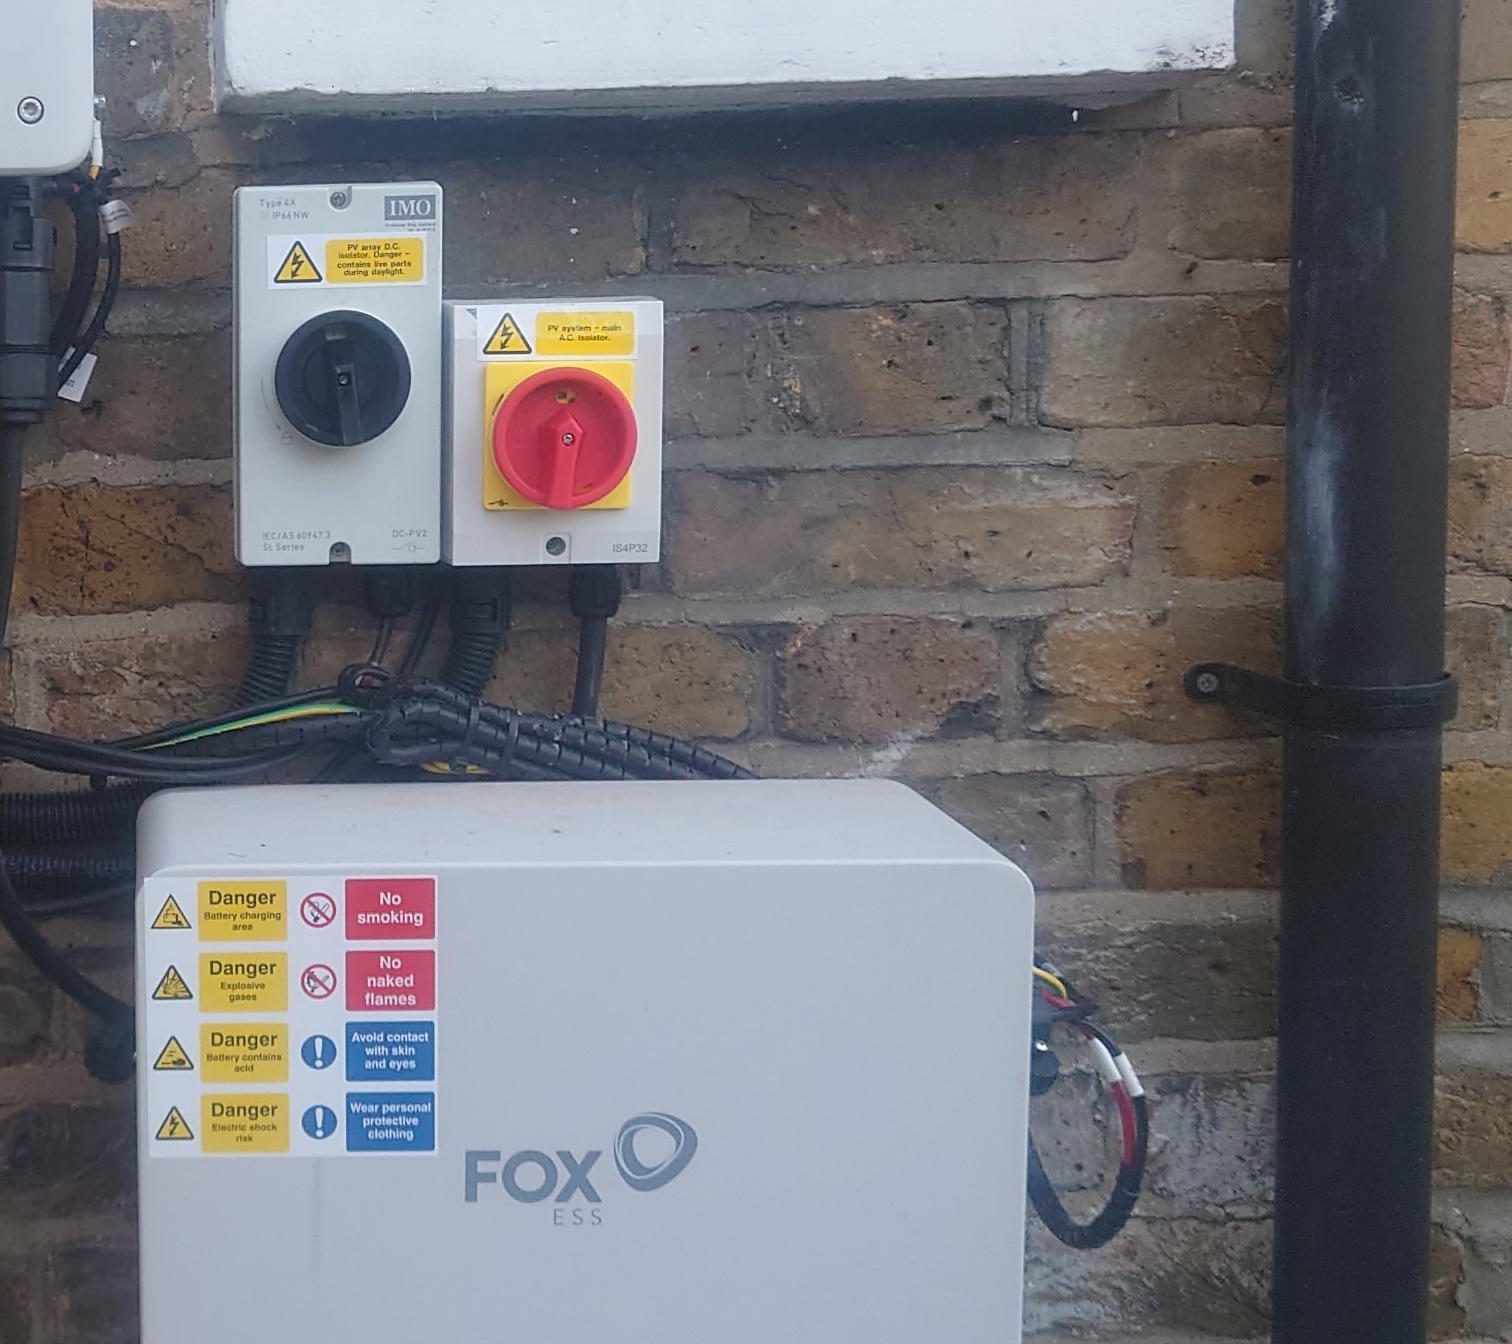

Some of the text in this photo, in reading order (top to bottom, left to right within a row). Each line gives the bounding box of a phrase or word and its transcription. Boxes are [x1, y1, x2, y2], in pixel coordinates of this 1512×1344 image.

[389, 198, 431, 216] IMO
[361, 244, 382, 252] array
[373, 250, 402, 259] Danger
[337, 260, 412, 269] contains live parts
[343, 269, 368, 277] during
[547, 324, 559, 332] PV
[562, 325, 591, 333] system
[612, 543, 649, 553] IS4P32
[208, 890, 277, 909] Danger
[379, 891, 402, 906] No
[203, 911, 282, 921] Battery charging
[357, 910, 424, 927] smoking
[379, 955, 402, 969] No
[209, 960, 277, 979] Danger
[220, 981, 265, 991] Explosive
[367, 973, 414, 988] naked
[228, 994, 257, 1003] gases
[364, 992, 417, 1006] flames
[210, 1032, 278, 1051] Danger
[351, 1031, 429, 1043] Avoid contact
[364, 1045, 416, 1056] with skin
[206, 1052, 282, 1063] Battery contains
[234, 1064, 254, 1073] acid
[364, 1058, 416, 1072] and eyes
[211, 1102, 278, 1121] Danger
[350, 1101, 431, 1115] Wear personal
[211, 1123, 278, 1132] Electric shock
[362, 1115, 419, 1128] protective
[235, 1134, 253, 1143] risk
[367, 1128, 414, 1142] clothing
[464, 1149, 603, 1204] FOX
[552, 1208, 603, 1226] ESS
